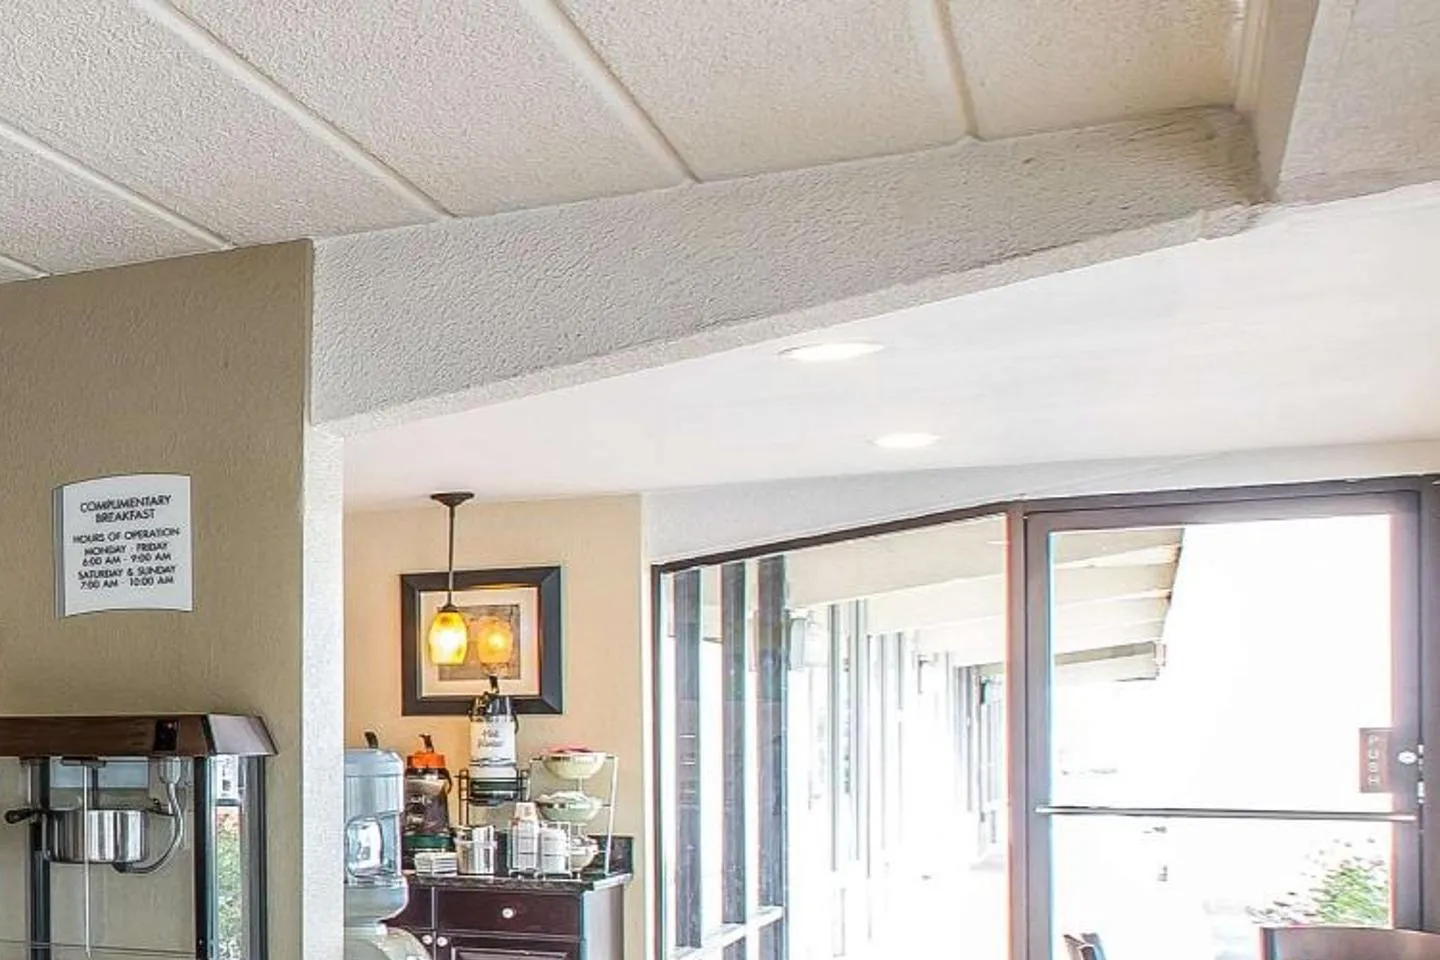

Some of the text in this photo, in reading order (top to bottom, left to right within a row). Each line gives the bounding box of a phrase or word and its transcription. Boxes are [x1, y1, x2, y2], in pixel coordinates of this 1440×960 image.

[80, 495, 172, 512] COMPLIMENTARY
[96, 509, 155, 523] BREAKFAST
[73, 528, 180, 543] HOURS OF OPERATION
[84, 545, 127, 555] MONDAY
[136, 543, 168, 552] FRIDAY
[82, 557, 102, 567] 6:00
[105, 556, 122, 564] AM
[130, 554, 152, 562] 9:00
[155, 553, 172, 561] AM
[78, 566, 176, 580] SATURDAY & SUNDAY
[80, 581, 100, 590] 7:00
[102, 580, 119, 588] AM
[130, 577, 154, 586] 10:00
[157, 576, 174, 584] AM
